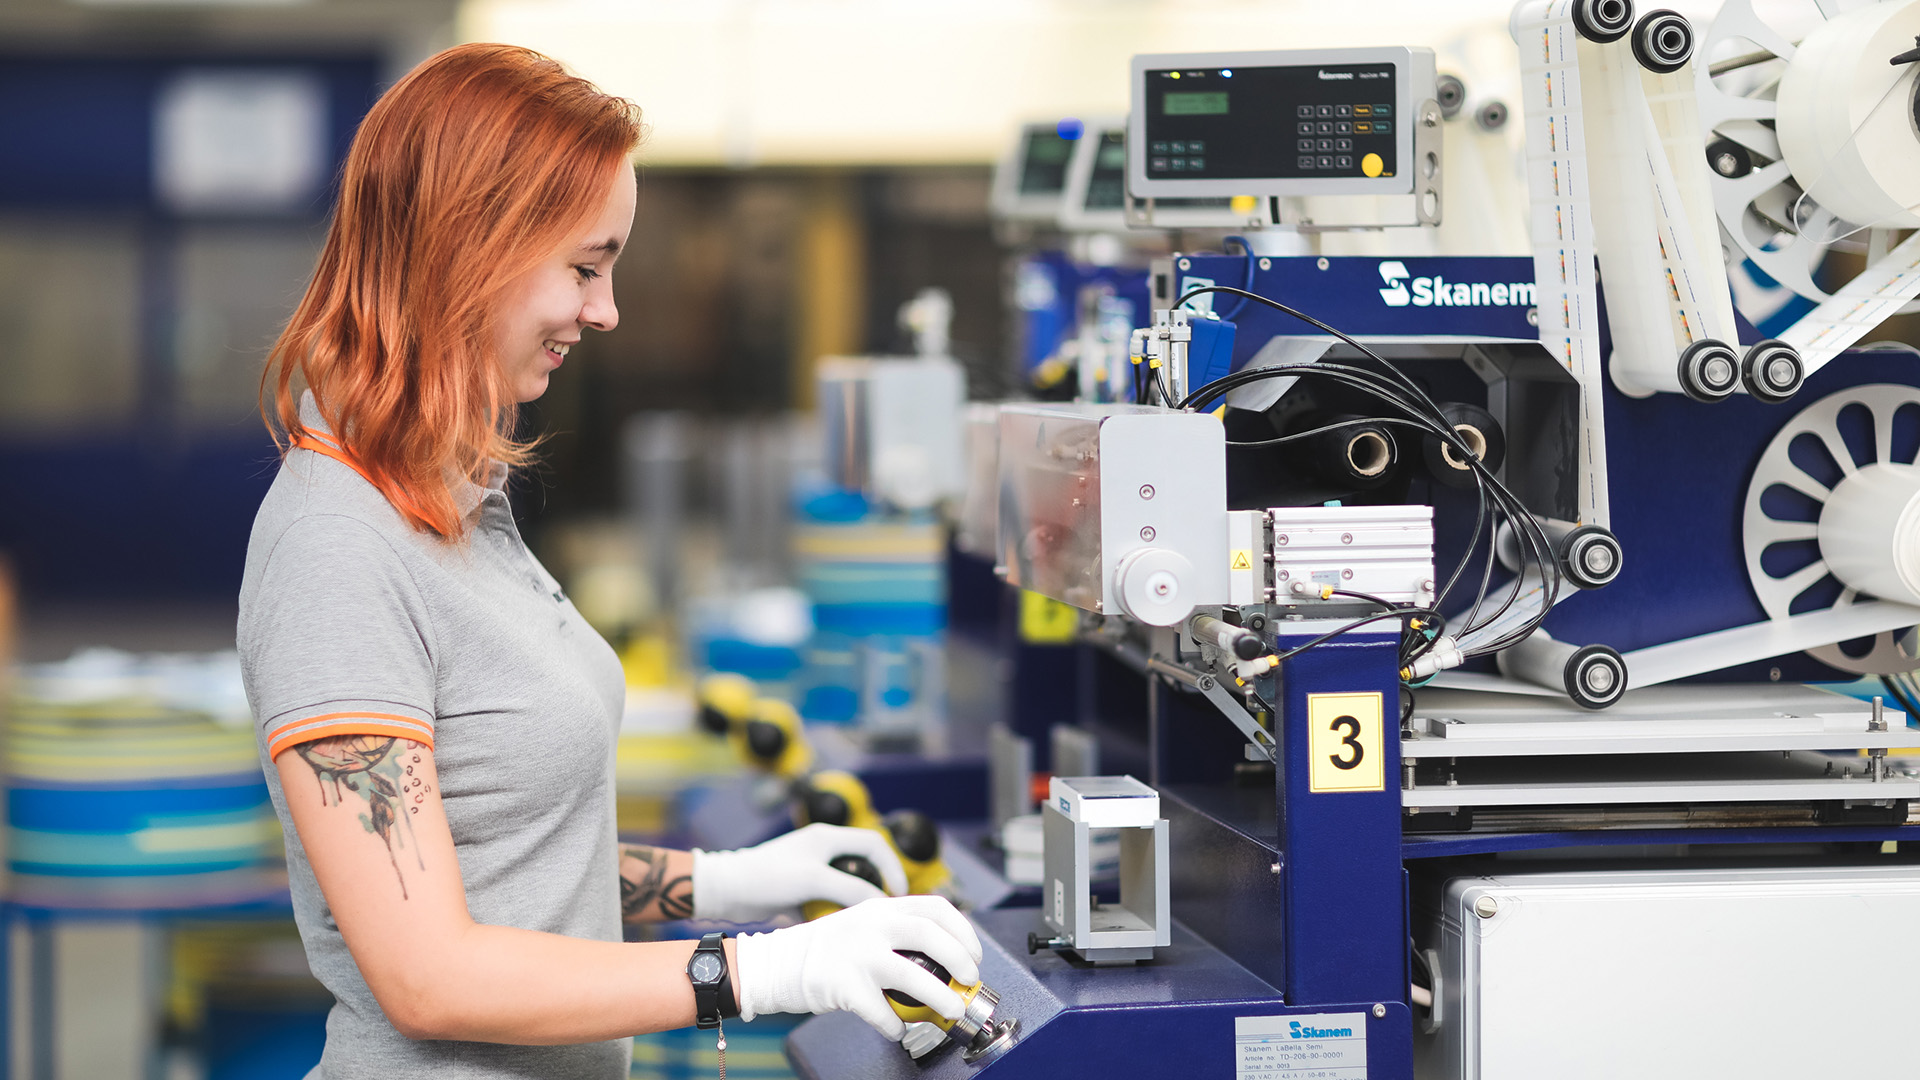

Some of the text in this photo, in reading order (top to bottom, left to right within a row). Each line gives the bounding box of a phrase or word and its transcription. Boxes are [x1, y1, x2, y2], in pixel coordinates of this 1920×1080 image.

[1411, 275, 1537, 306] Skanem
[1329, 715, 1364, 770] 3
[1302, 1027, 1352, 1038] Skanem
[1244, 1045, 1272, 1053] Skanem
[1305, 1043, 1324, 1051] Semi
